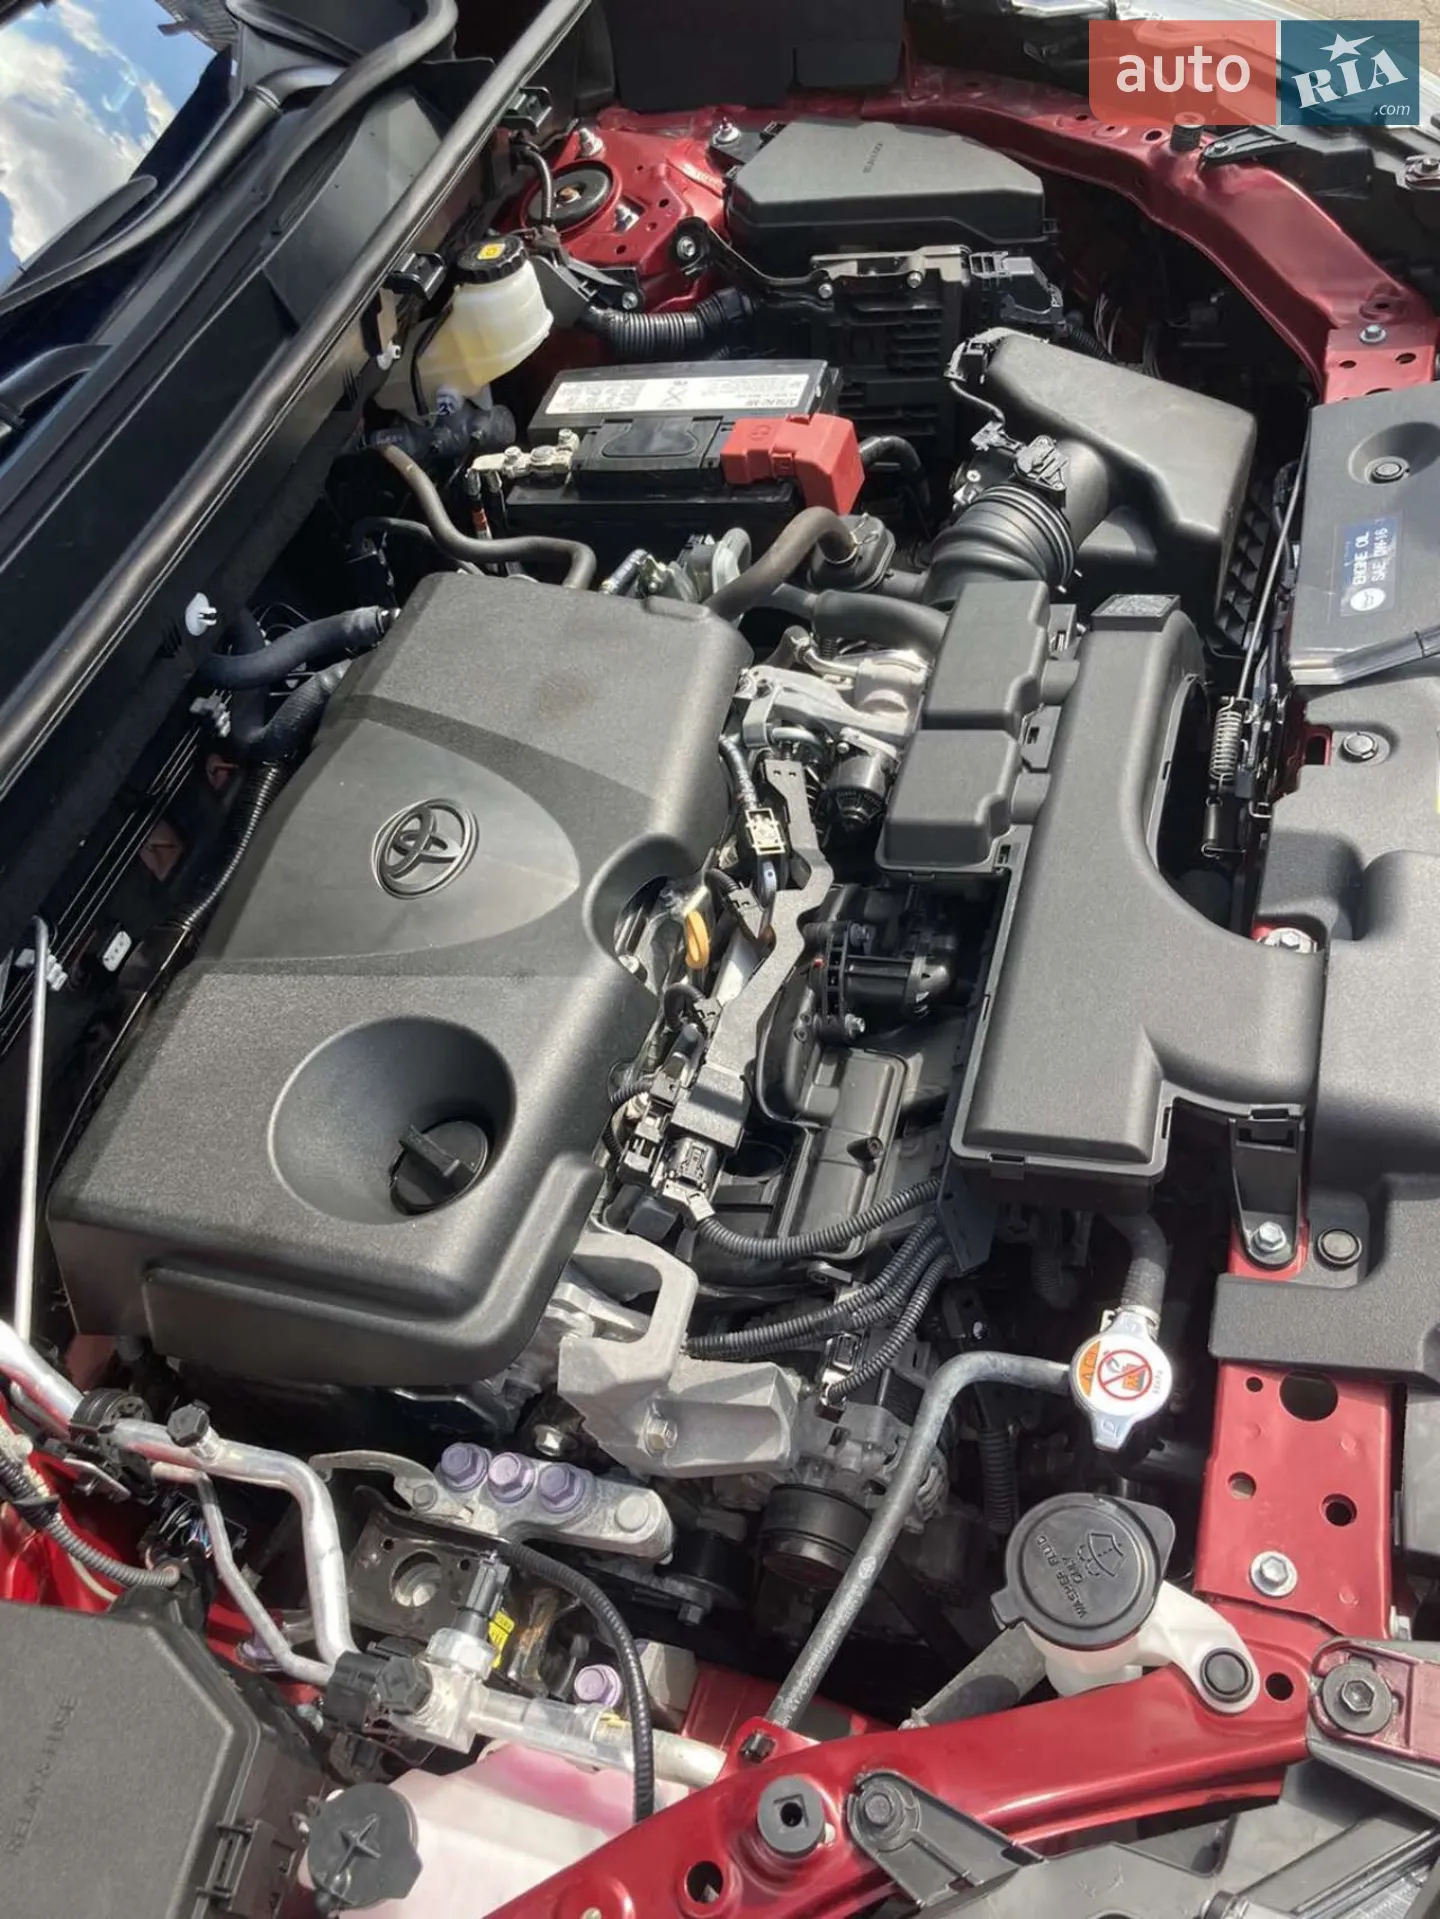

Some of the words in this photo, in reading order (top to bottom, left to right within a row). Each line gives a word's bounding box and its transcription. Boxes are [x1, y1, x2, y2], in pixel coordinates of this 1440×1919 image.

[1037, 1534, 1061, 1567] FLUID
[1062, 1556, 1084, 1584] ONLY
[1055, 1571, 1088, 1619] WASHER
